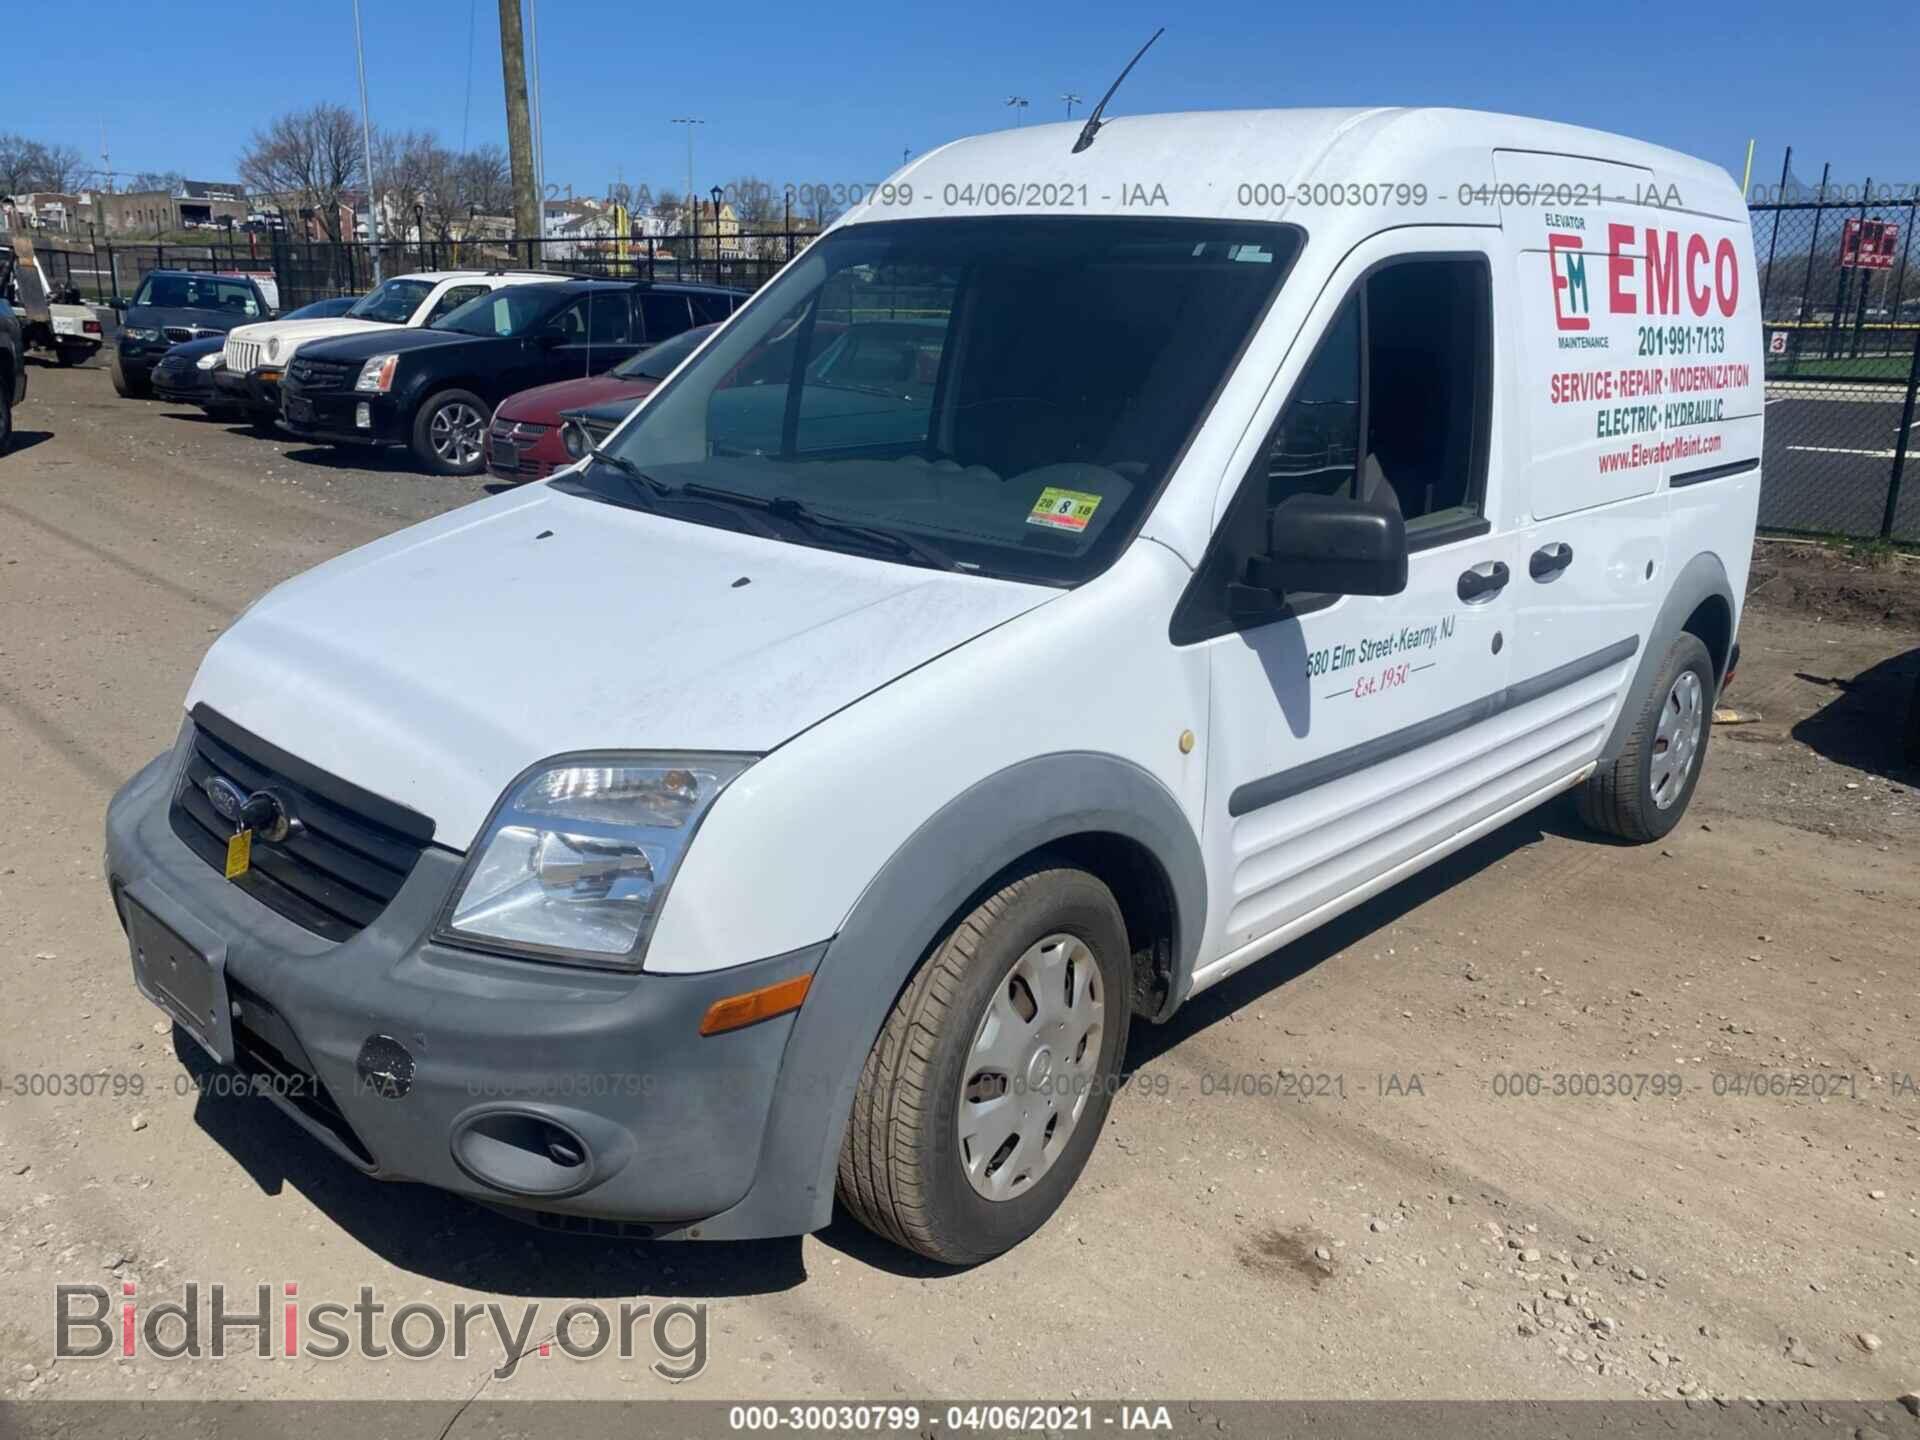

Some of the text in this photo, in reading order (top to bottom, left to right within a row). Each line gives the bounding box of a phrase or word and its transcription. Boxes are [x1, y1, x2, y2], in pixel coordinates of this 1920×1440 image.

[1544, 213, 1586, 231] ELEVATOR
[1608, 223, 1739, 317] EMCO
[1557, 336, 1610, 349] MAINTENANCE
[1773, 337, 1784, 351] 3
[1598, 435, 1722, 474] www.ElevatorMaint.com
[1059, 500, 1072, 514] 8
[1331, 644, 1356, 672] Elm
[1439, 614, 1456, 641] NJ
[1354, 676, 1377, 699] Est.
